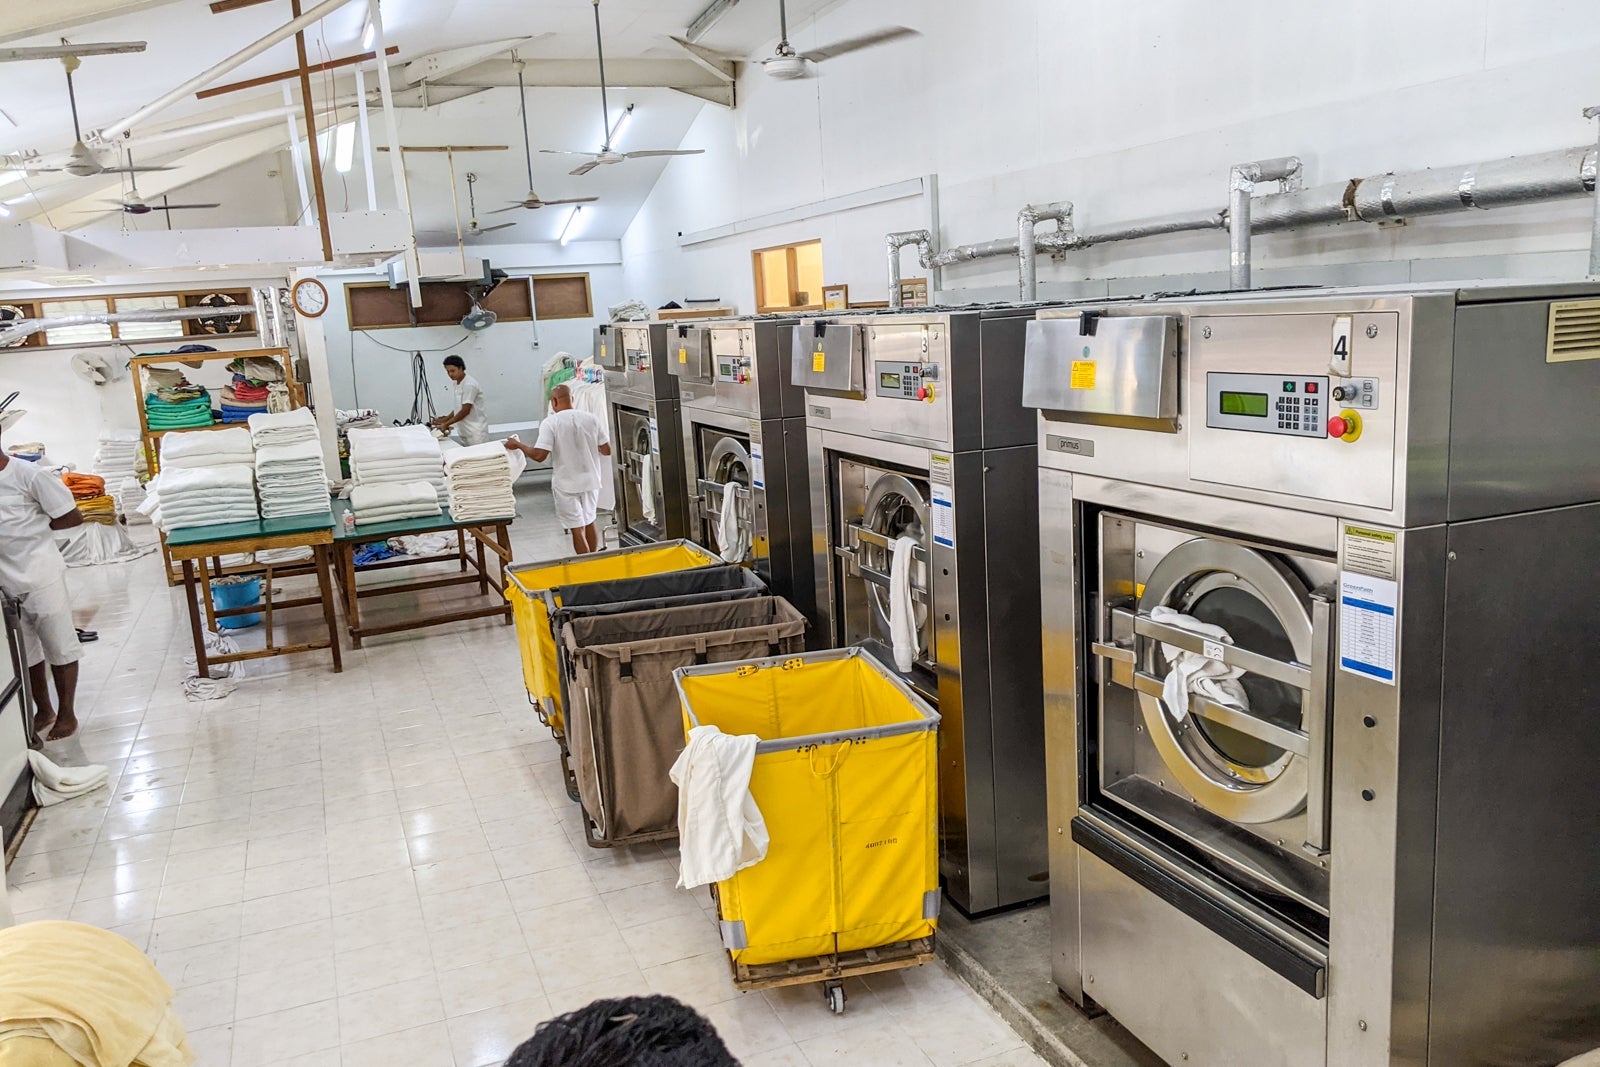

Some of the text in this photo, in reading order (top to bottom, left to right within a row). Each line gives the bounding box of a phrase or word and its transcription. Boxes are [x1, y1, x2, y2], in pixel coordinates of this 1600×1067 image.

[739, 338, 744, 350] 2
[922, 336, 928, 353] 3
[1333, 335, 1348, 361] 4
[1343, 582, 1373, 593] GreenPath
